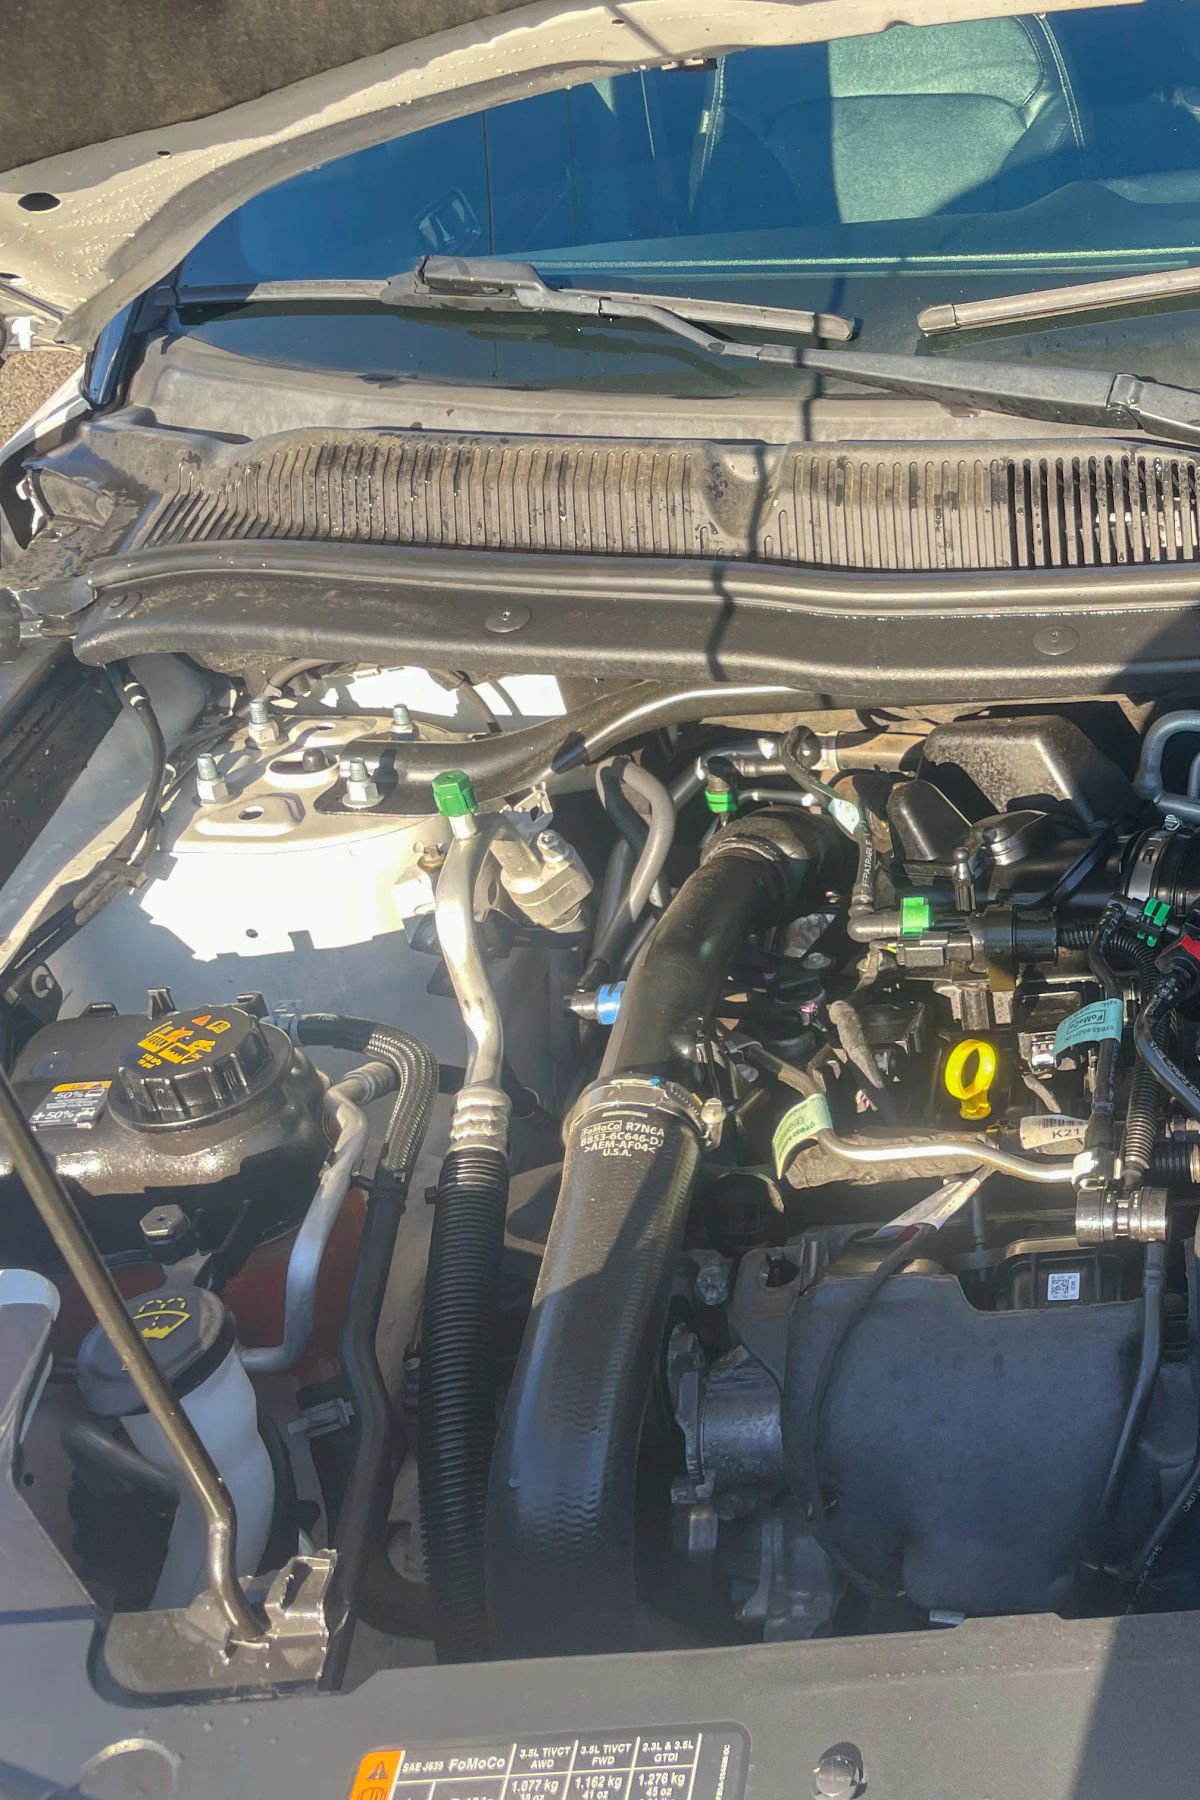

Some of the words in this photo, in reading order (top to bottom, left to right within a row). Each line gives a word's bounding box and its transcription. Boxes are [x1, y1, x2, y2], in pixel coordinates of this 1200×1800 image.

[1069, 1013, 1104, 1029] FoMoCo
[54, 1090, 84, 1100] 50%
[583, 1122, 620, 1135] FoMoCo
[1052, 1128, 1080, 1139] K21
[602, 1148, 633, 1157] U.S.A.
[580, 1745, 600, 1755] 3.5L
[642, 1742, 662, 1752] 2.3L
[664, 1741, 672, 1751] &
[674, 1740, 694, 1750] 3.5L
[520, 1747, 540, 1758] 3.5L
[654, 1752, 679, 1763] GTDI
[448, 1756, 505, 1772] FoMoCo
[530, 1759, 555, 1769] AWD
[592, 1756, 615, 1766] FWD
[402, 1762, 422, 1773] SAE
[422, 1761, 444, 1771] J639
[575, 1776, 606, 1789] 1.162
[608, 1775, 622, 1790] kg
[638, 1772, 669, 1786] 1.276
[671, 1772, 686, 1787] kg
[511, 1779, 542, 1792] 1.077
[544, 1779, 559, 1795] kg
[646, 1787, 658, 1797] 45
[660, 1787, 672, 1796] oz
[582, 1790, 594, 1800] 41
[596, 1790, 609, 1799] oz
